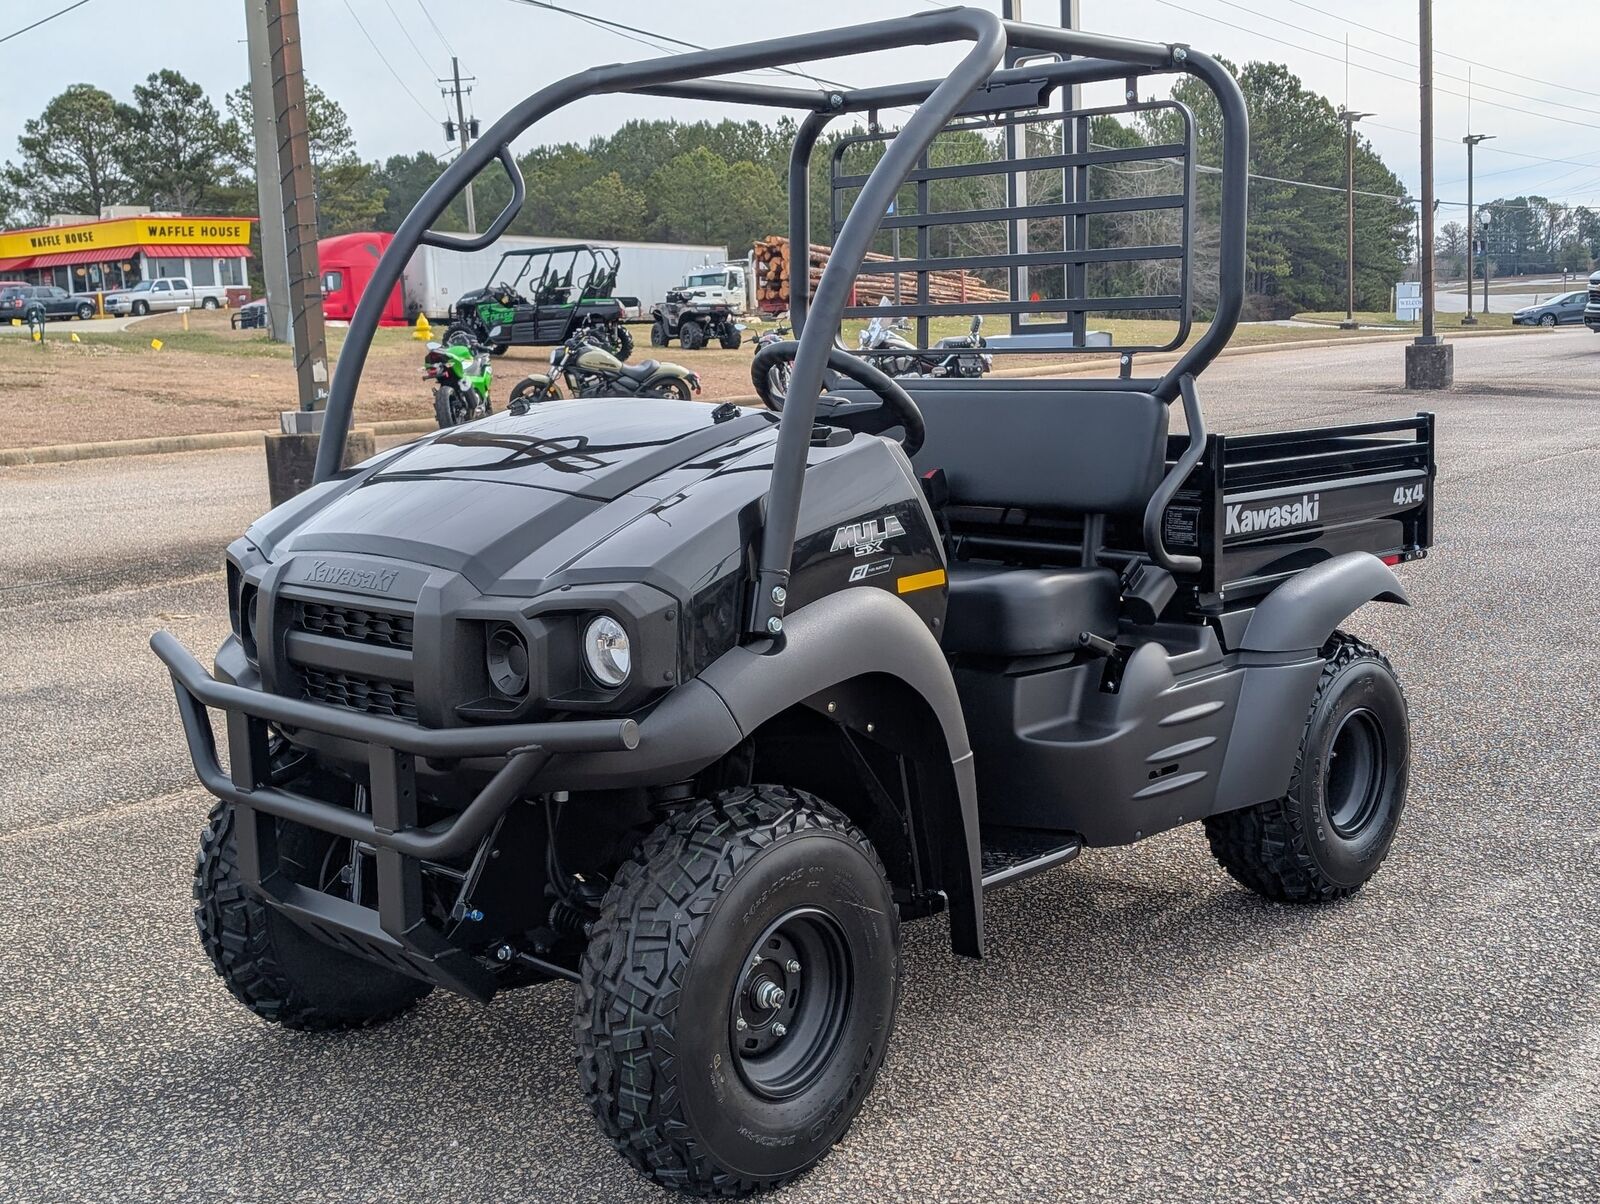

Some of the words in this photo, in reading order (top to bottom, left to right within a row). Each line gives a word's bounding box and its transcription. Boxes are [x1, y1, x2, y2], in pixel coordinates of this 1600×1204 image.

[30, 235, 61, 248] WAFFLE
[65, 231, 94, 244] HOUSE
[148, 225, 195, 237] WAFFLE
[201, 226, 241, 237] HOUSE
[1392, 483, 1425, 505] 4x4
[1225, 493, 1320, 535] Kawasaki
[829, 515, 907, 553] MULE
[853, 540, 885, 558] SX
[303, 559, 400, 593] Kawasaki
